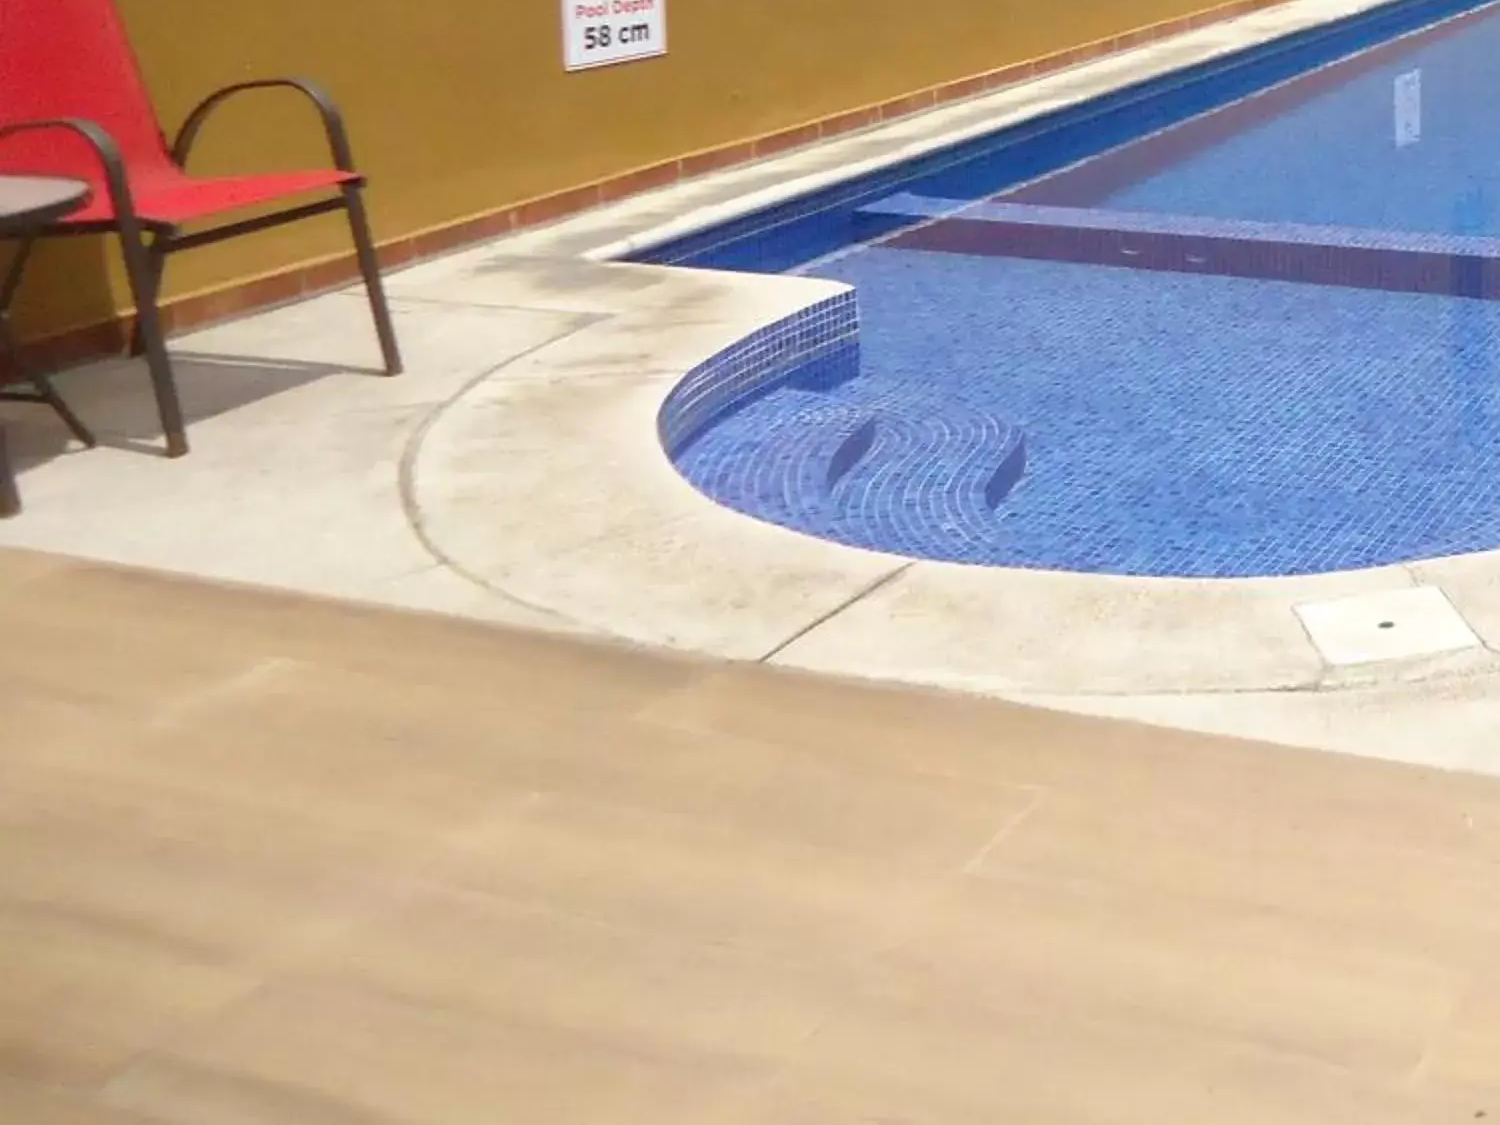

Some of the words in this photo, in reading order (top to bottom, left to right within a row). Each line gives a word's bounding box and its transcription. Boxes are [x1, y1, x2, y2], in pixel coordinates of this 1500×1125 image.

[575, 1, 608, 19] Pool
[584, 24, 611, 49] 58
[618, 22, 650, 44] cm
